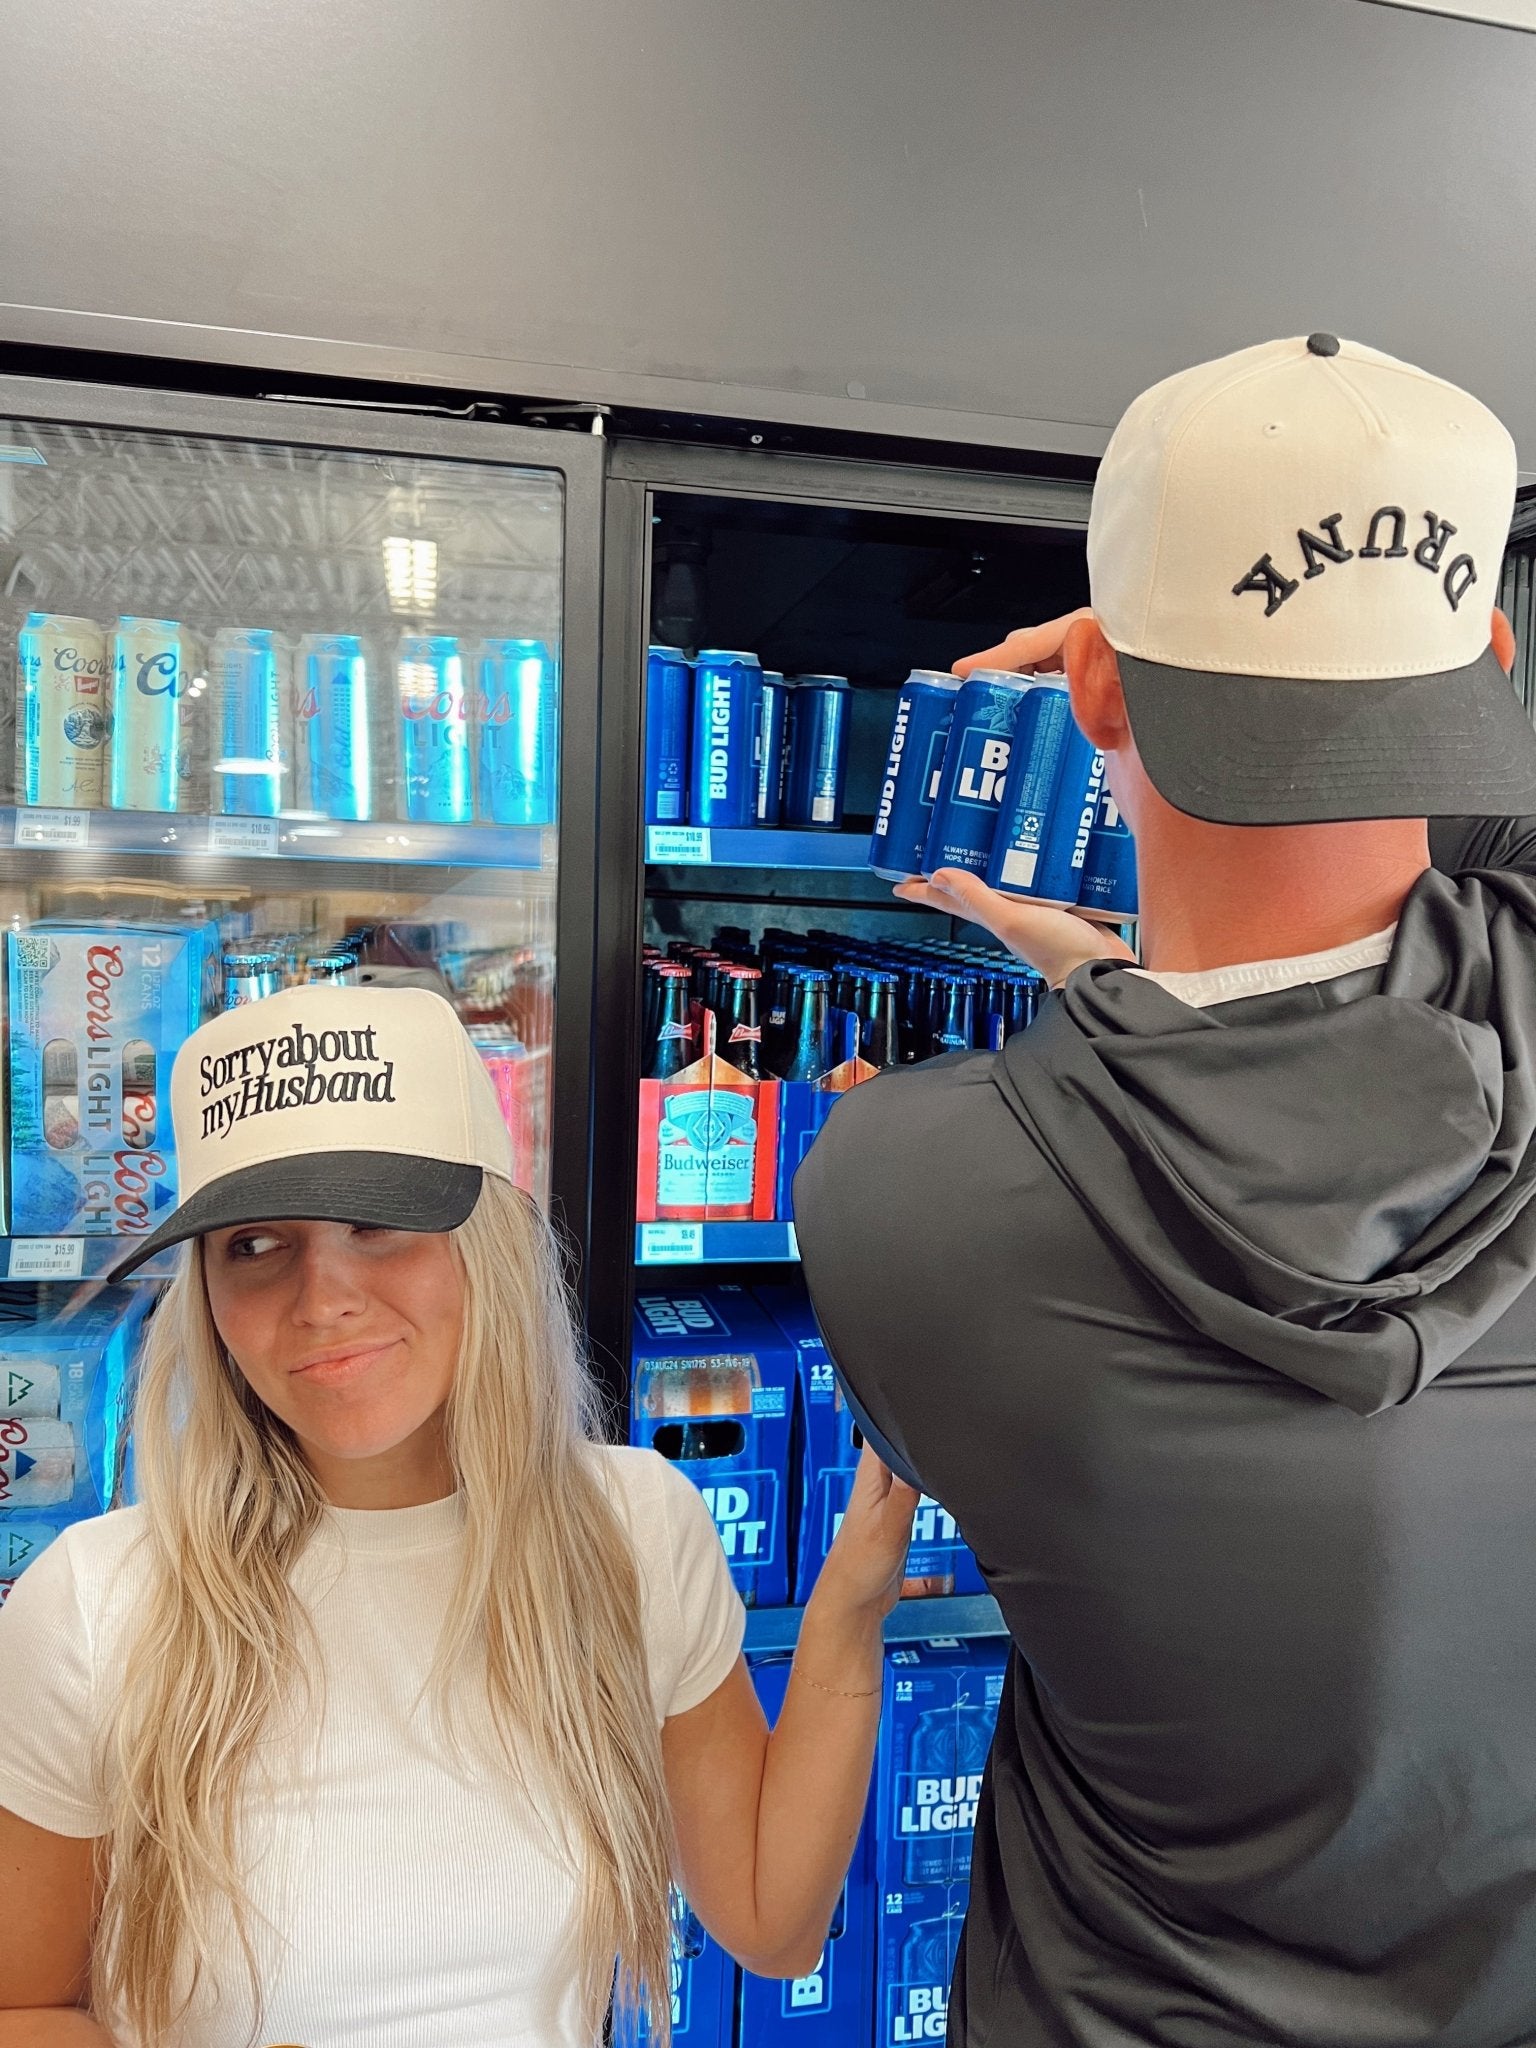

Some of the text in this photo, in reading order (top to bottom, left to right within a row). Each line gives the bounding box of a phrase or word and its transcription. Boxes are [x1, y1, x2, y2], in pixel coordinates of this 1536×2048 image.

[1232, 505, 1477, 617] DRUNK
[710, 675, 731, 800] BUD LIGHT
[876, 698, 912, 836] BUD LIGHT
[1071, 748, 1105, 868] BUD LIG
[943, 845, 990, 859] ALWAYS BREW
[1095, 886, 1111, 894] RICE
[141, 944, 161, 967] 12
[141, 973, 152, 1010] CANS
[86, 944, 124, 1132] Coors LIGHT
[664, 1154, 749, 1170] Budweiser
[113, 1149, 167, 1235] Coor
[54, 1244, 75, 1255] $15.99
[638, 1296, 688, 1335] LIGHT
[671, 1300, 715, 1329] BUD
[68, 1360, 84, 1379] 18
[811, 1365, 834, 1380] 12
[896, 1681, 913, 1693] 12
[917, 1775, 983, 1805] BUD
[902, 1802, 978, 1832] LIGH
[886, 1893, 903, 1905] 12
[909, 1986, 951, 2015] BU
[894, 2012, 946, 2042] LIG
